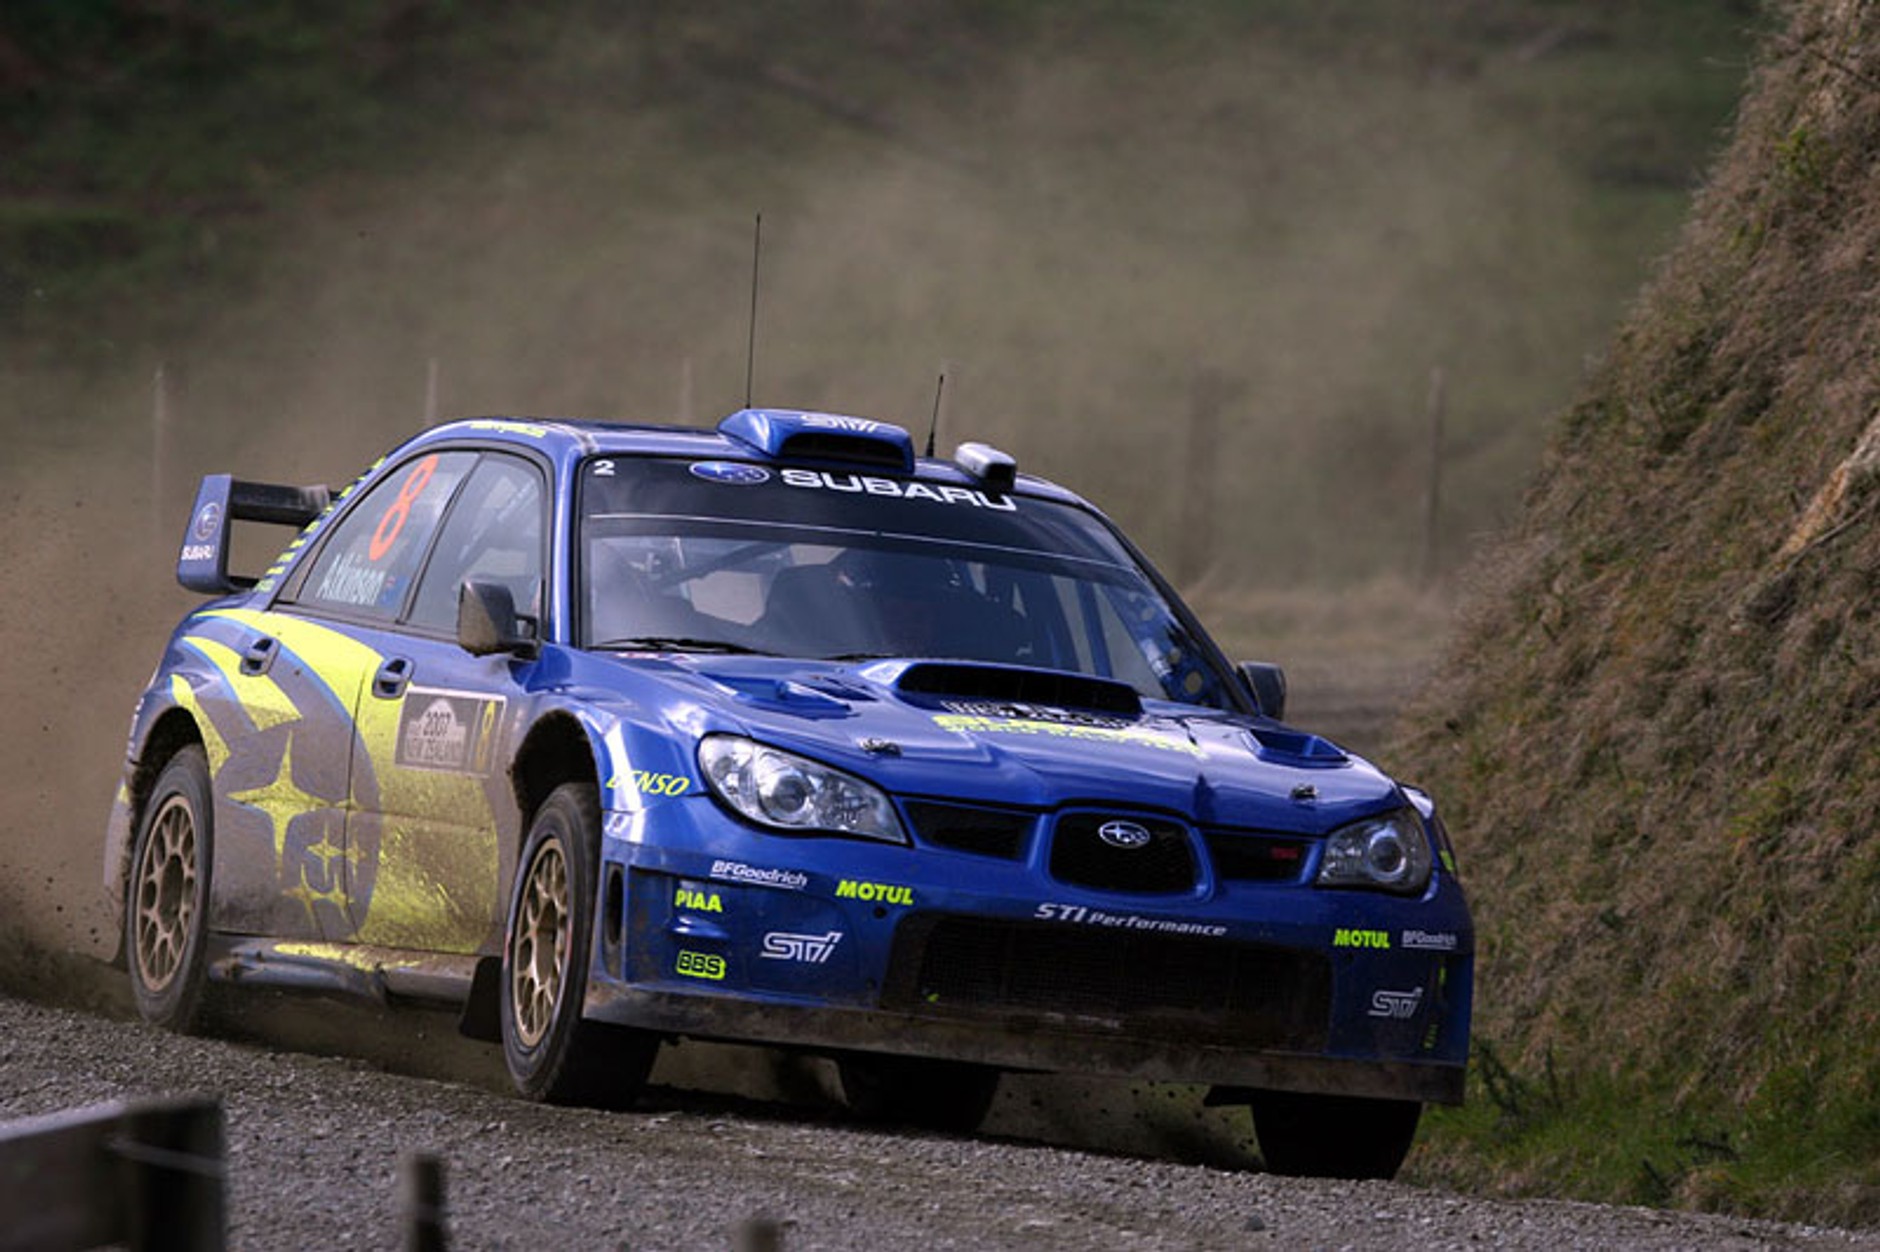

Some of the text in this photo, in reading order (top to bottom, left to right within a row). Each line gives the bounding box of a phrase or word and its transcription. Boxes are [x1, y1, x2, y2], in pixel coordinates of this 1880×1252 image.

[592, 459, 617, 476] 2
[781, 469, 1017, 511] SUBARU
[368, 454, 440, 561] 8
[711, 860, 808, 888] BFGoodrich
[674, 889, 723, 913] PIAA
[835, 880, 915, 905] MOTUL
[1034, 902, 1228, 937] STI Performance
[1333, 928, 1391, 950] MOTUL
[678, 951, 725, 979] BBS
